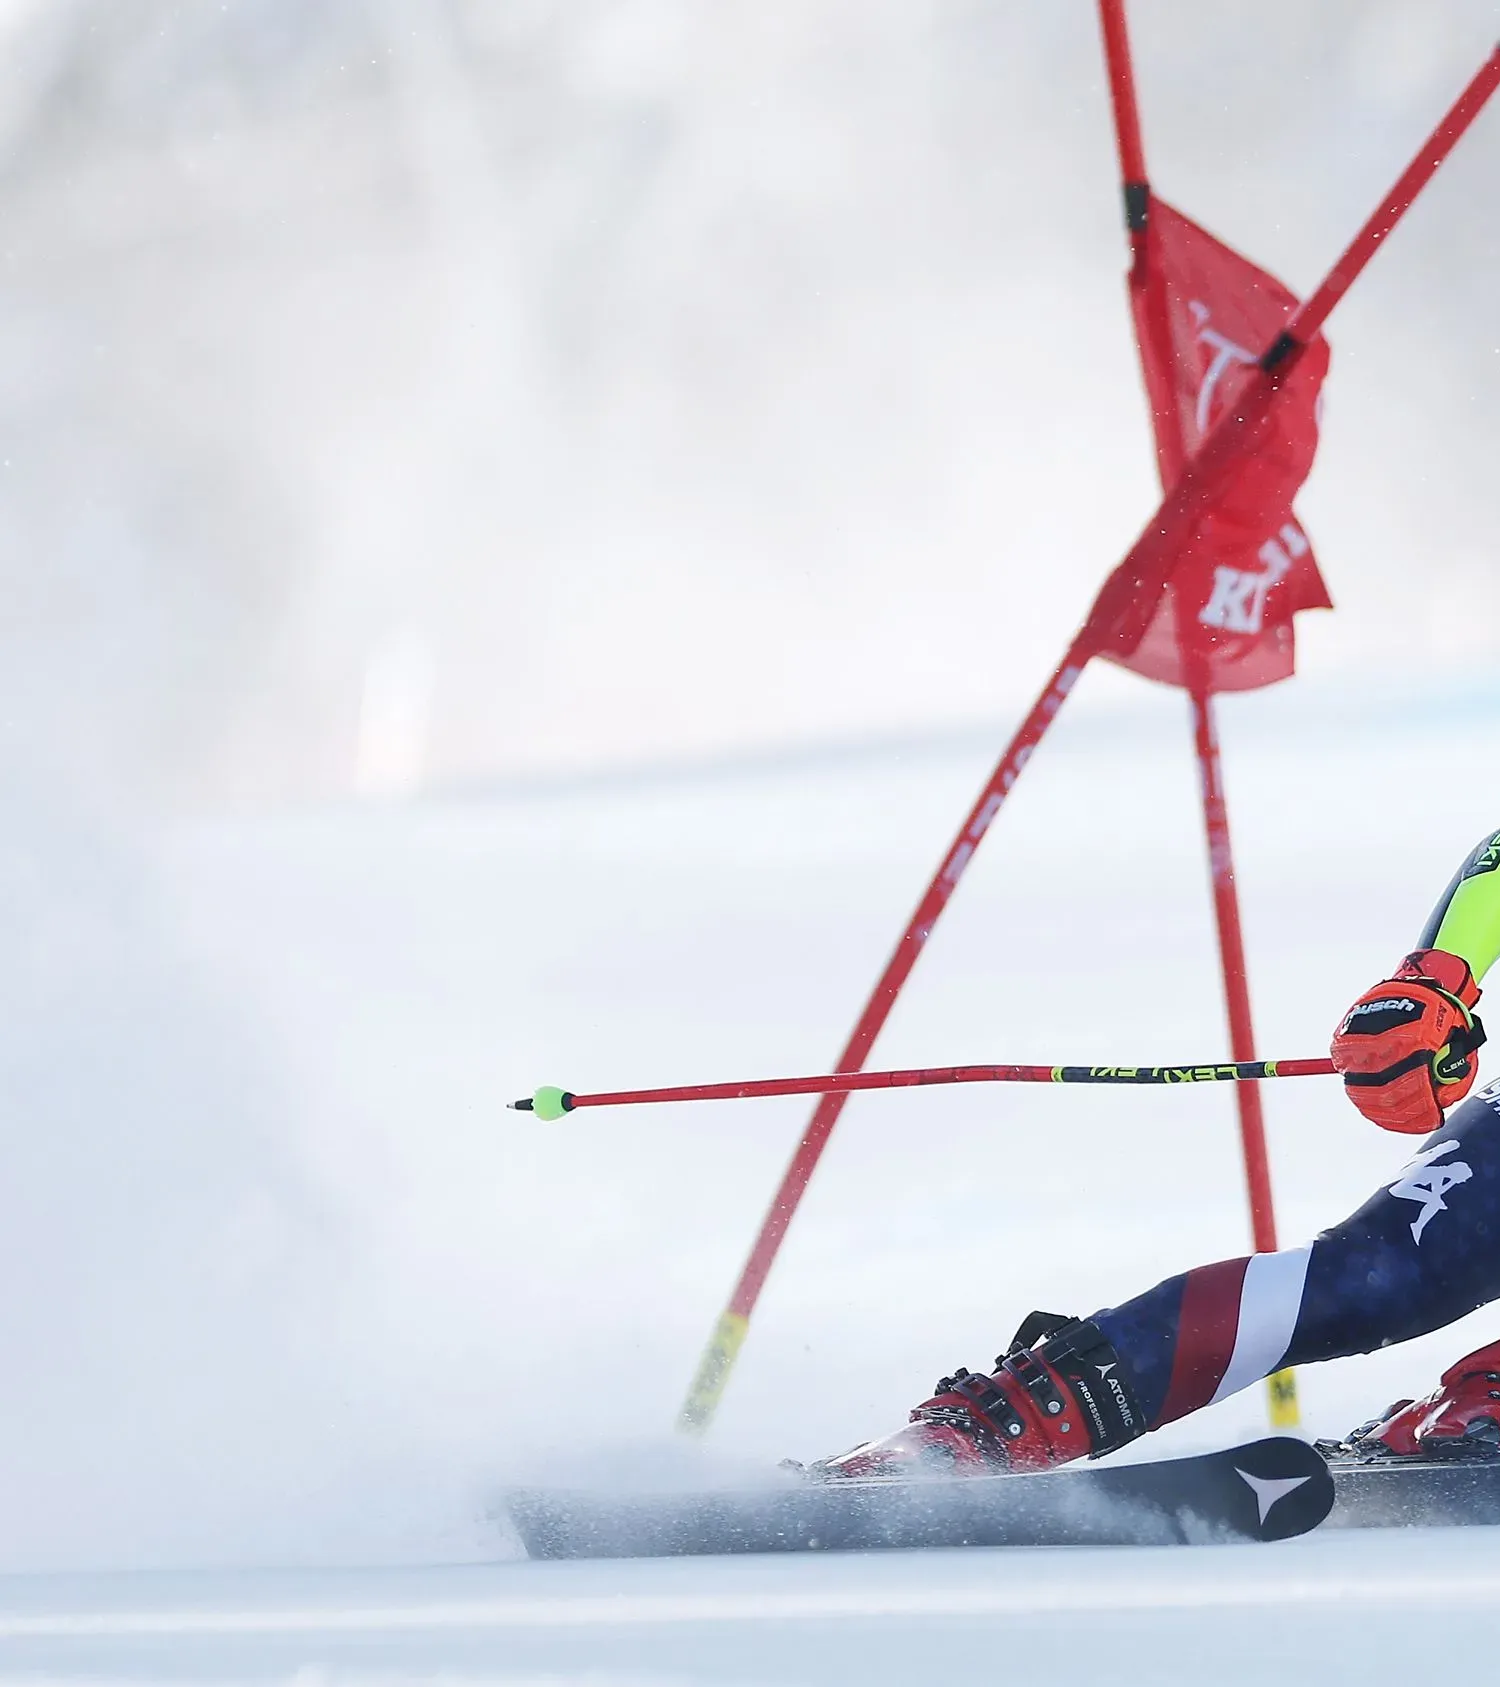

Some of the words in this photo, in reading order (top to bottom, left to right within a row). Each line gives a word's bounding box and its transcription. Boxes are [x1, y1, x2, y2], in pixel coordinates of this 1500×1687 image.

[1443, 1058, 1466, 1073] LEKI
[1077, 1380, 1107, 1439] PROFESSIONAL
[1107, 1378, 1134, 1427] ATOMIC
